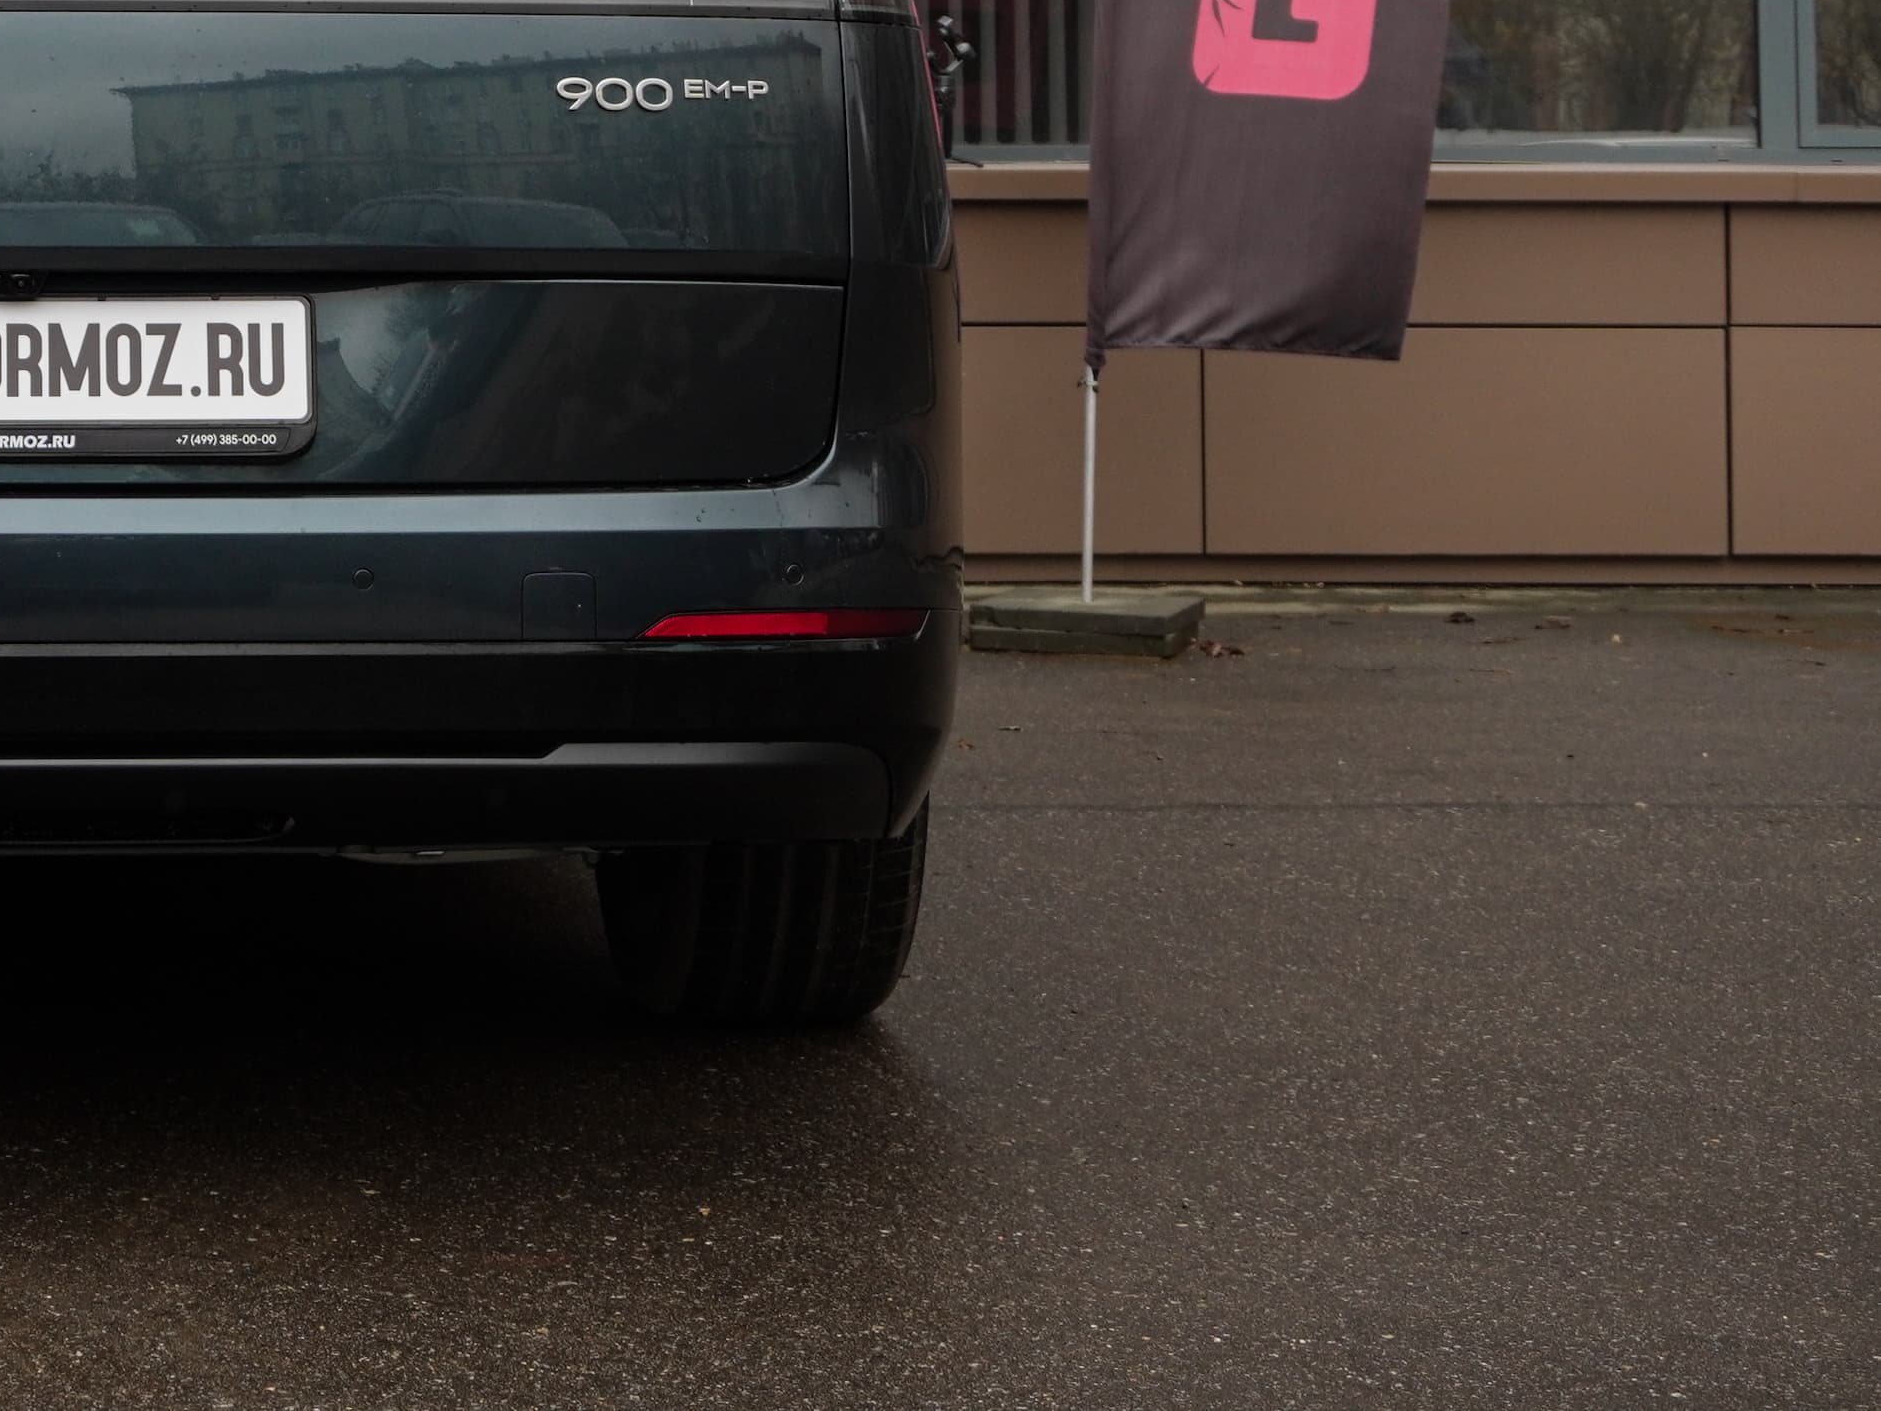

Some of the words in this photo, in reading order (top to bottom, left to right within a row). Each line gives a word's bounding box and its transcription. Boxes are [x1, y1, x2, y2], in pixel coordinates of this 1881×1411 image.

[556, 77, 674, 111] 900
[684, 79, 769, 100] EM-P
[176, 434, 188, 445] +7
[190, 433, 217, 446] (499)
[219, 434, 277, 445] 385-00-00
